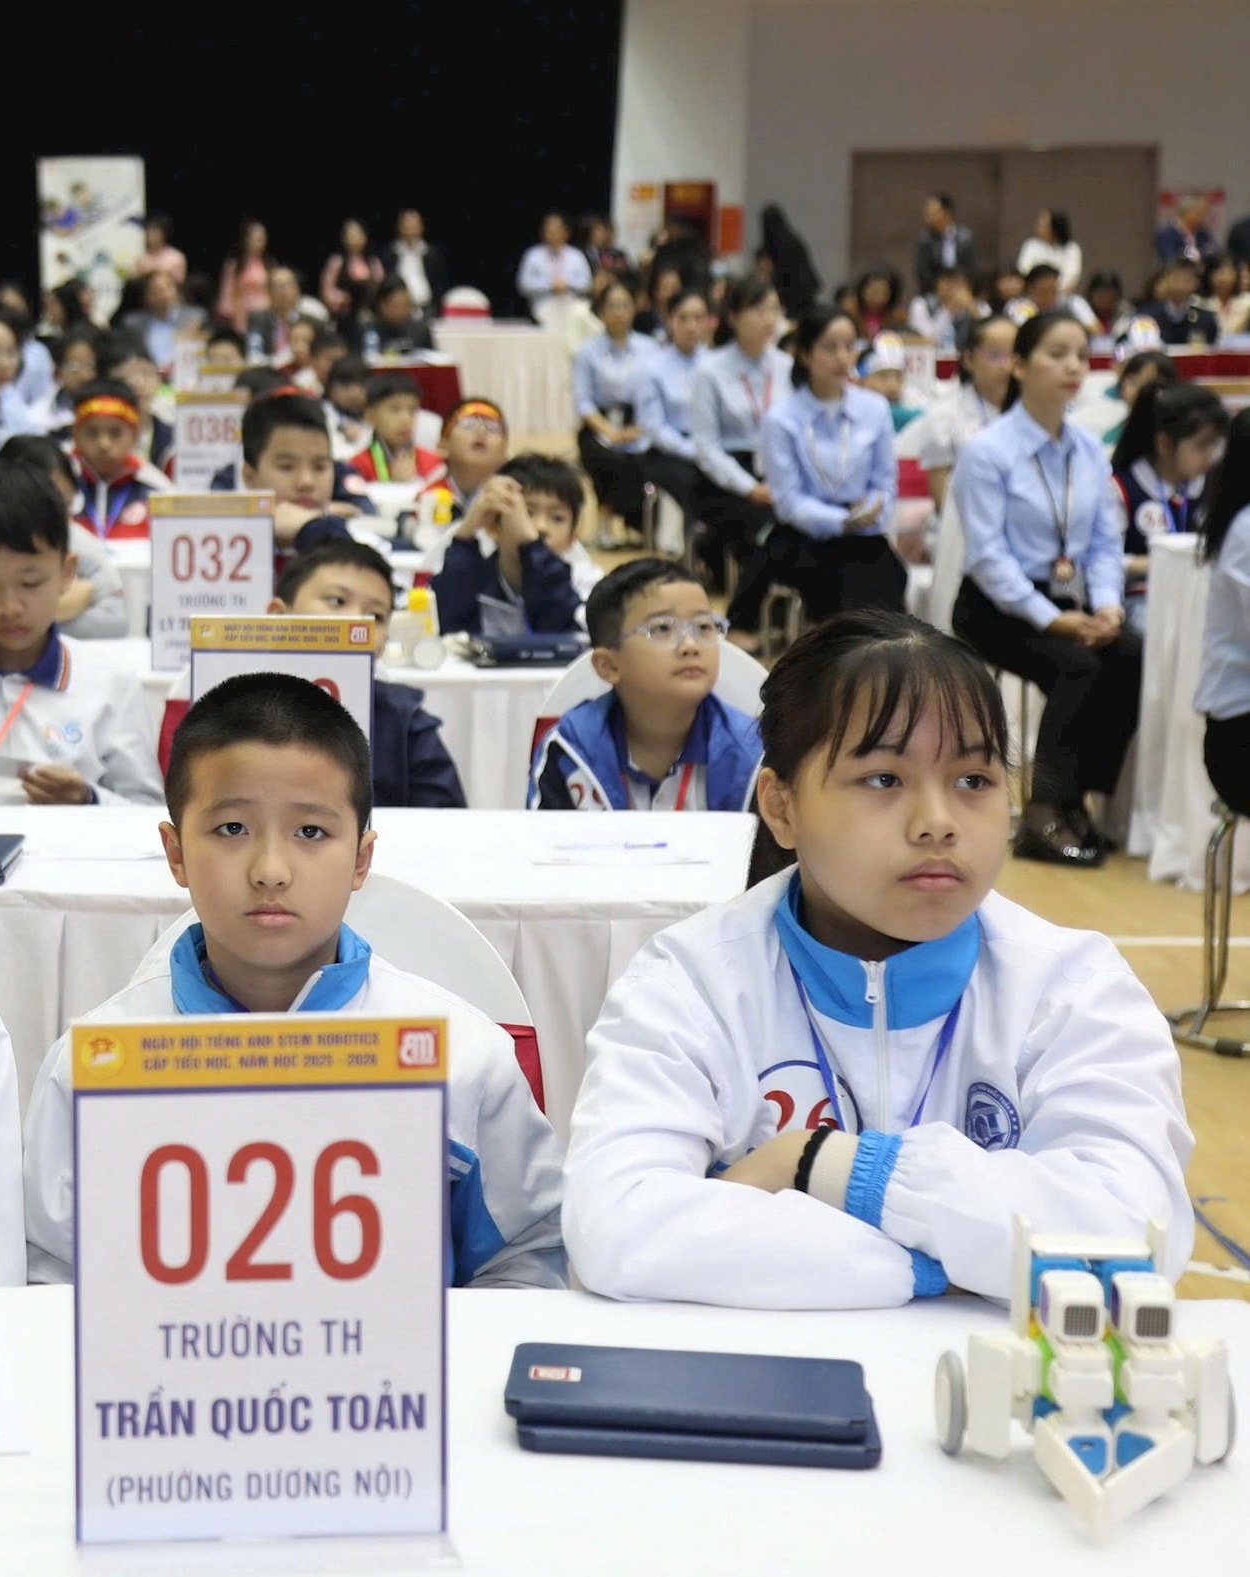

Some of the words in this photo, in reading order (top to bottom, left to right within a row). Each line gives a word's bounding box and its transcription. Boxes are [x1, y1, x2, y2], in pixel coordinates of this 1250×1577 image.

[171, 534, 252, 582] 032
[248, 1034, 273, 1048] ANH
[279, 1032, 313, 1047] STEM
[318, 1032, 380, 1047] ROBOTICS
[348, 1053, 378, 1067] 2026
[138, 1140, 383, 1286] 026
[159, 1316, 302, 1359] TRƯỜNG
[320, 1319, 362, 1355] TH
[96, 1385, 195, 1438] TRẦN
[211, 1384, 312, 1439] QUỐC
[326, 1380, 426, 1431] TOẢN
[106, 1471, 232, 1508] (PHƯỜNG
[247, 1470, 341, 1501] DƯƠNG
[354, 1468, 412, 1501] NỘI)
